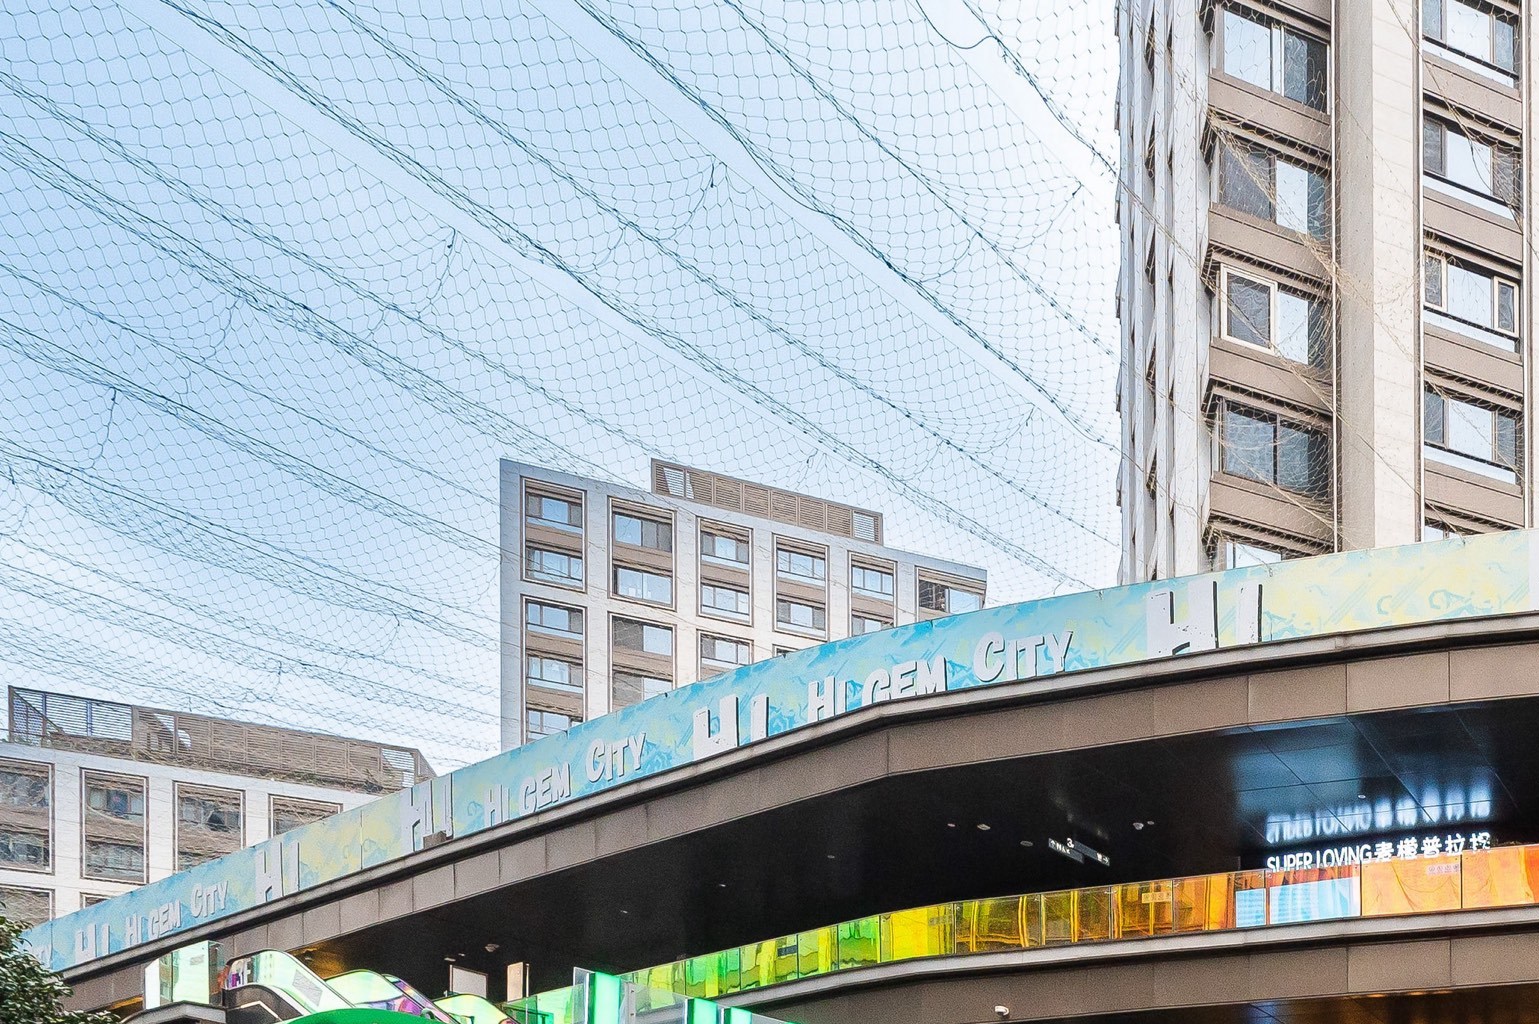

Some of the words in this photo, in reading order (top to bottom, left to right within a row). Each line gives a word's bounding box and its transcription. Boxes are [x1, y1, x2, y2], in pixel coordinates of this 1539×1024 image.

[1146, 580, 1265, 660] HI
[808, 676, 849, 726] HI
[861, 653, 949, 706] GEM
[973, 629, 1074, 684] CITY
[692, 695, 769, 762] HI
[520, 760, 572, 821] GEM
[585, 730, 648, 784] CITY
[252, 841, 301, 901] HI
[148, 899, 183, 942] GEM
[188, 879, 231, 919] CITY
